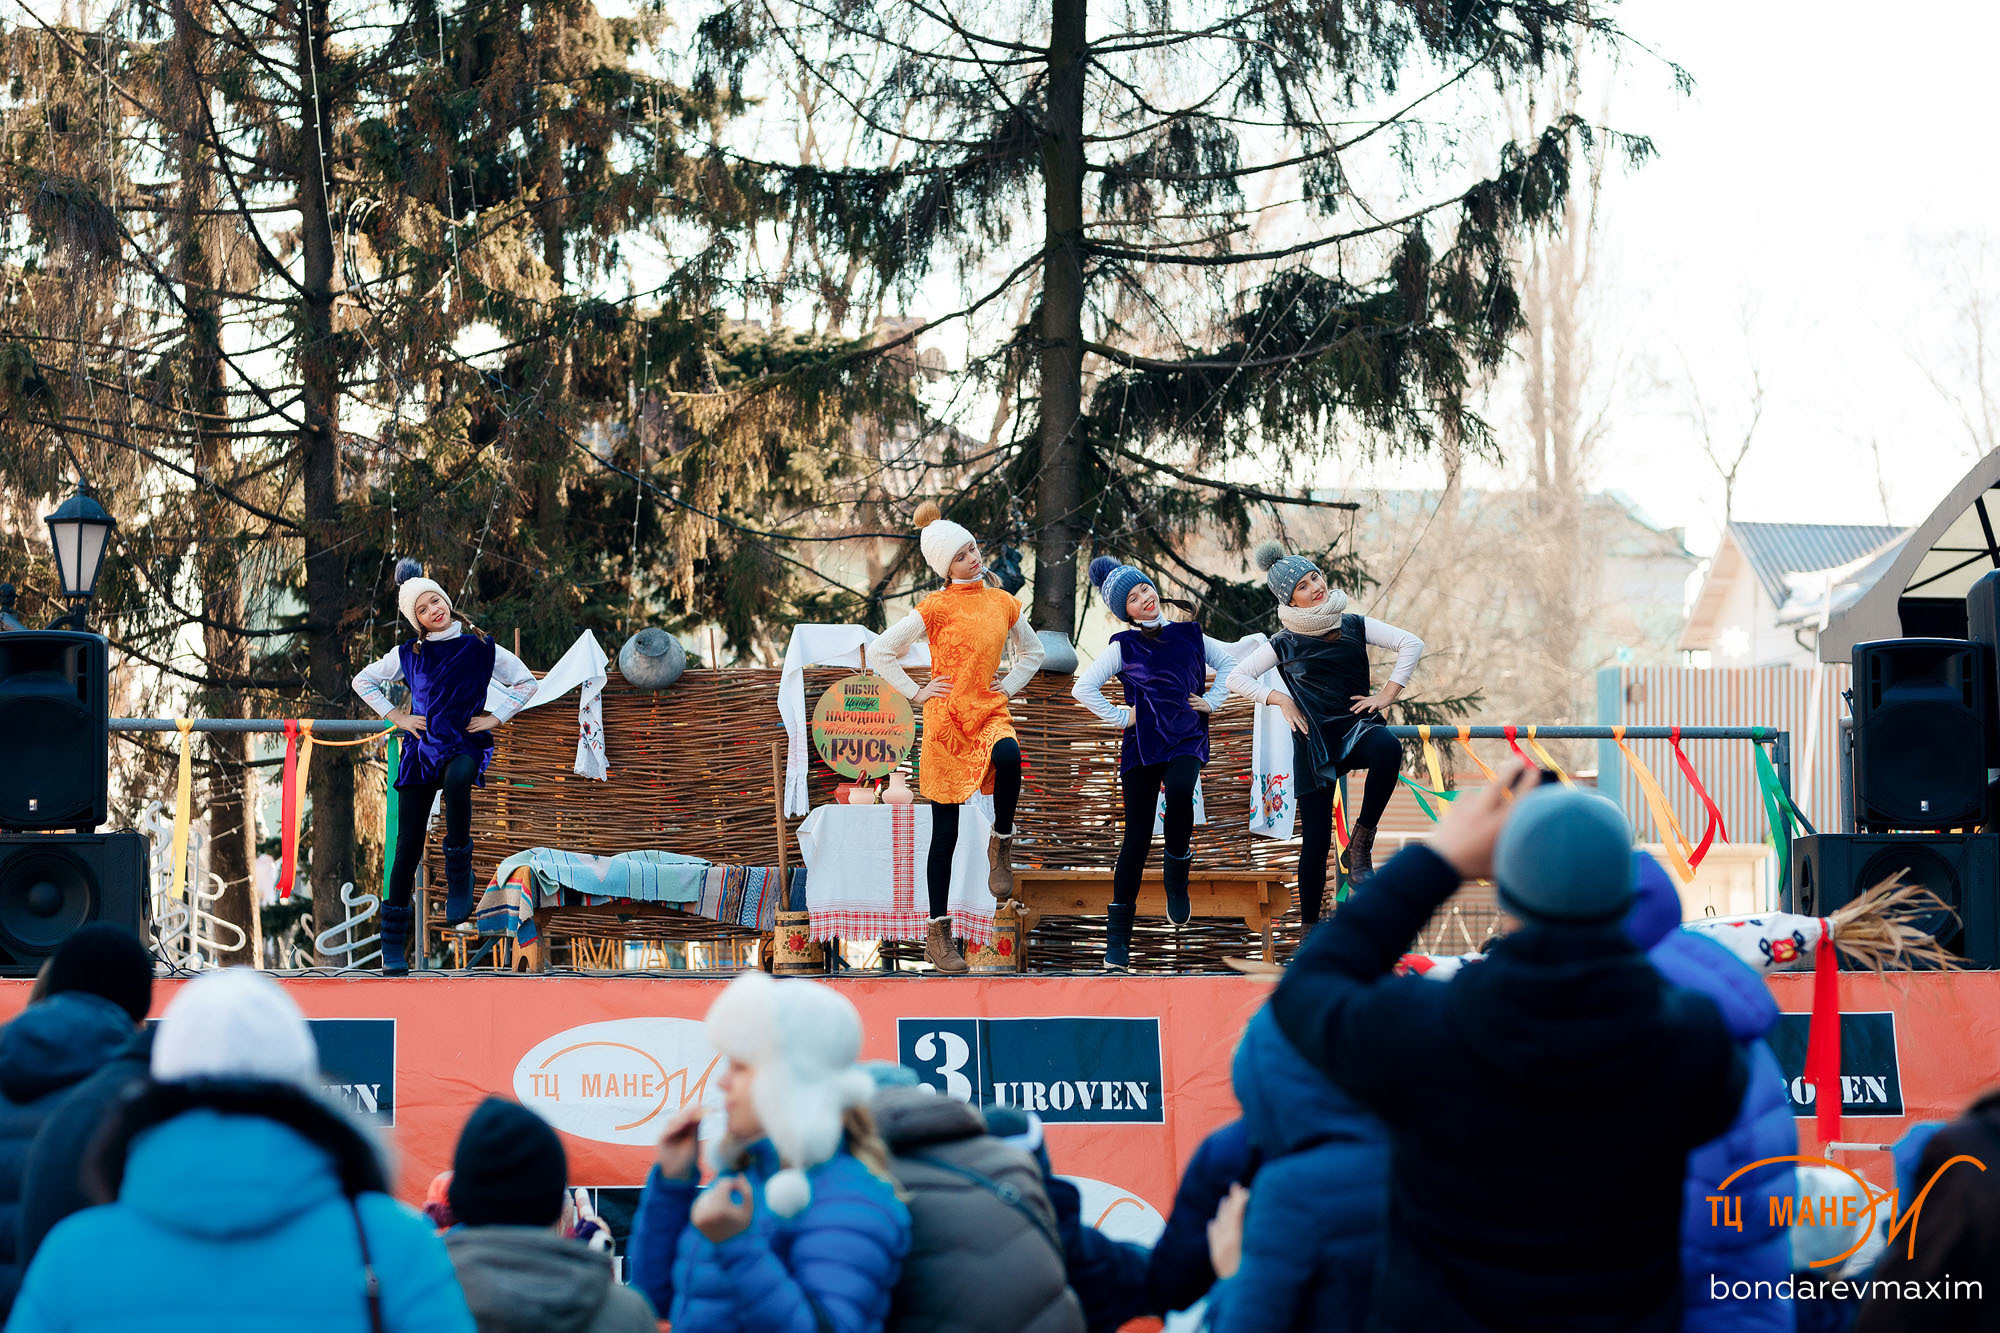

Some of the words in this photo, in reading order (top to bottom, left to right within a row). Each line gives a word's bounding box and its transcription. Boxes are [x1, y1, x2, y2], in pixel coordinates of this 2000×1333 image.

[845, 684, 879, 695] МБУК
[826, 711, 895, 725] НАРОДНОГО
[914, 1031, 973, 1106] 3
[993, 1080, 1149, 1111] UROVEN
[529, 1073, 560, 1102] ТЦ
